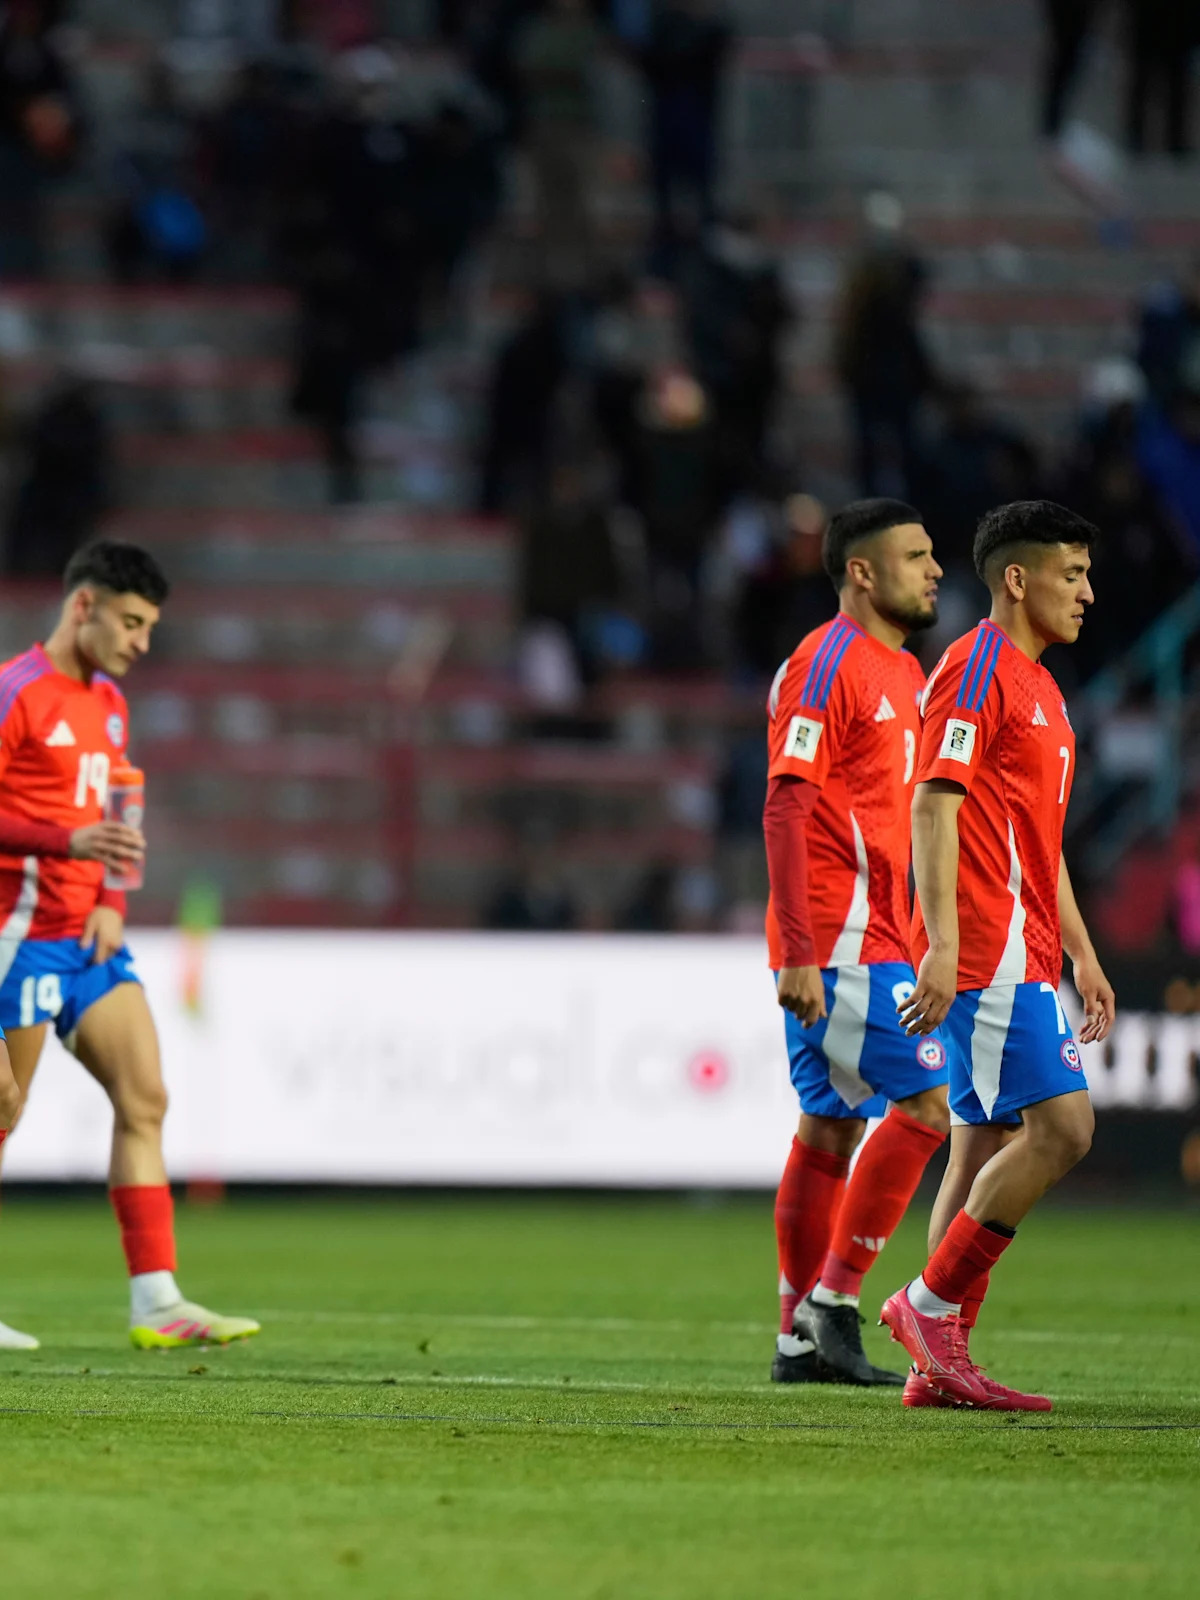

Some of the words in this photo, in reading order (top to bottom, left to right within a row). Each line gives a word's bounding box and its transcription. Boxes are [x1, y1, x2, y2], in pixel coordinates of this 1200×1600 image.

[75, 751, 110, 808] 19
[1058, 745, 1070, 805] 7
[20, 972, 64, 1028] 19
[1039, 982, 1067, 1035] 7
